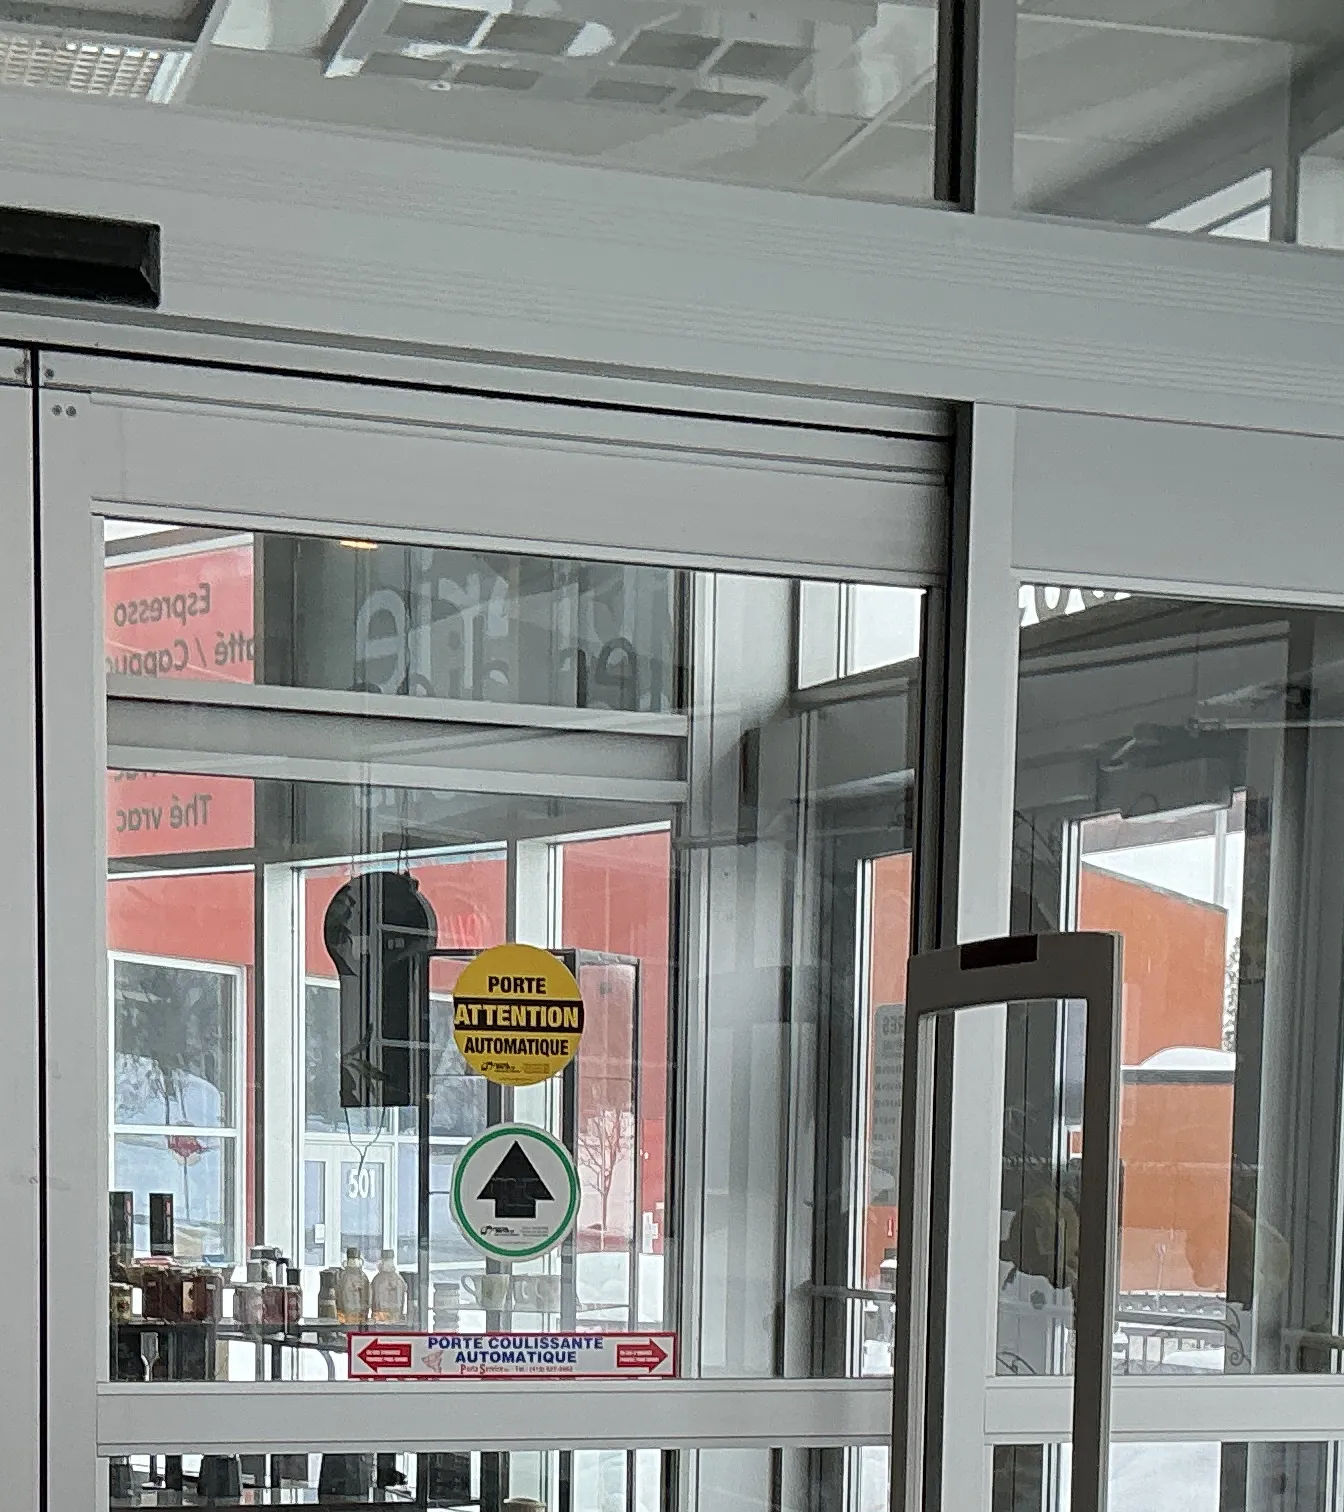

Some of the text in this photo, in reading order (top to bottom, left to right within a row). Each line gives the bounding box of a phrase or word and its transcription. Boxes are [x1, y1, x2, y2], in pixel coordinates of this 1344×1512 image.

[488, 976, 546, 994] PORTE
[455, 1003, 580, 1029] ATTENTION
[464, 1037, 569, 1056] AUTOMATIQUE
[348, 1168, 376, 1199] 501
[428, 1337, 604, 1350] PORTE COULISSANTE
[455, 1351, 577, 1364] AUTOMATIQUE
